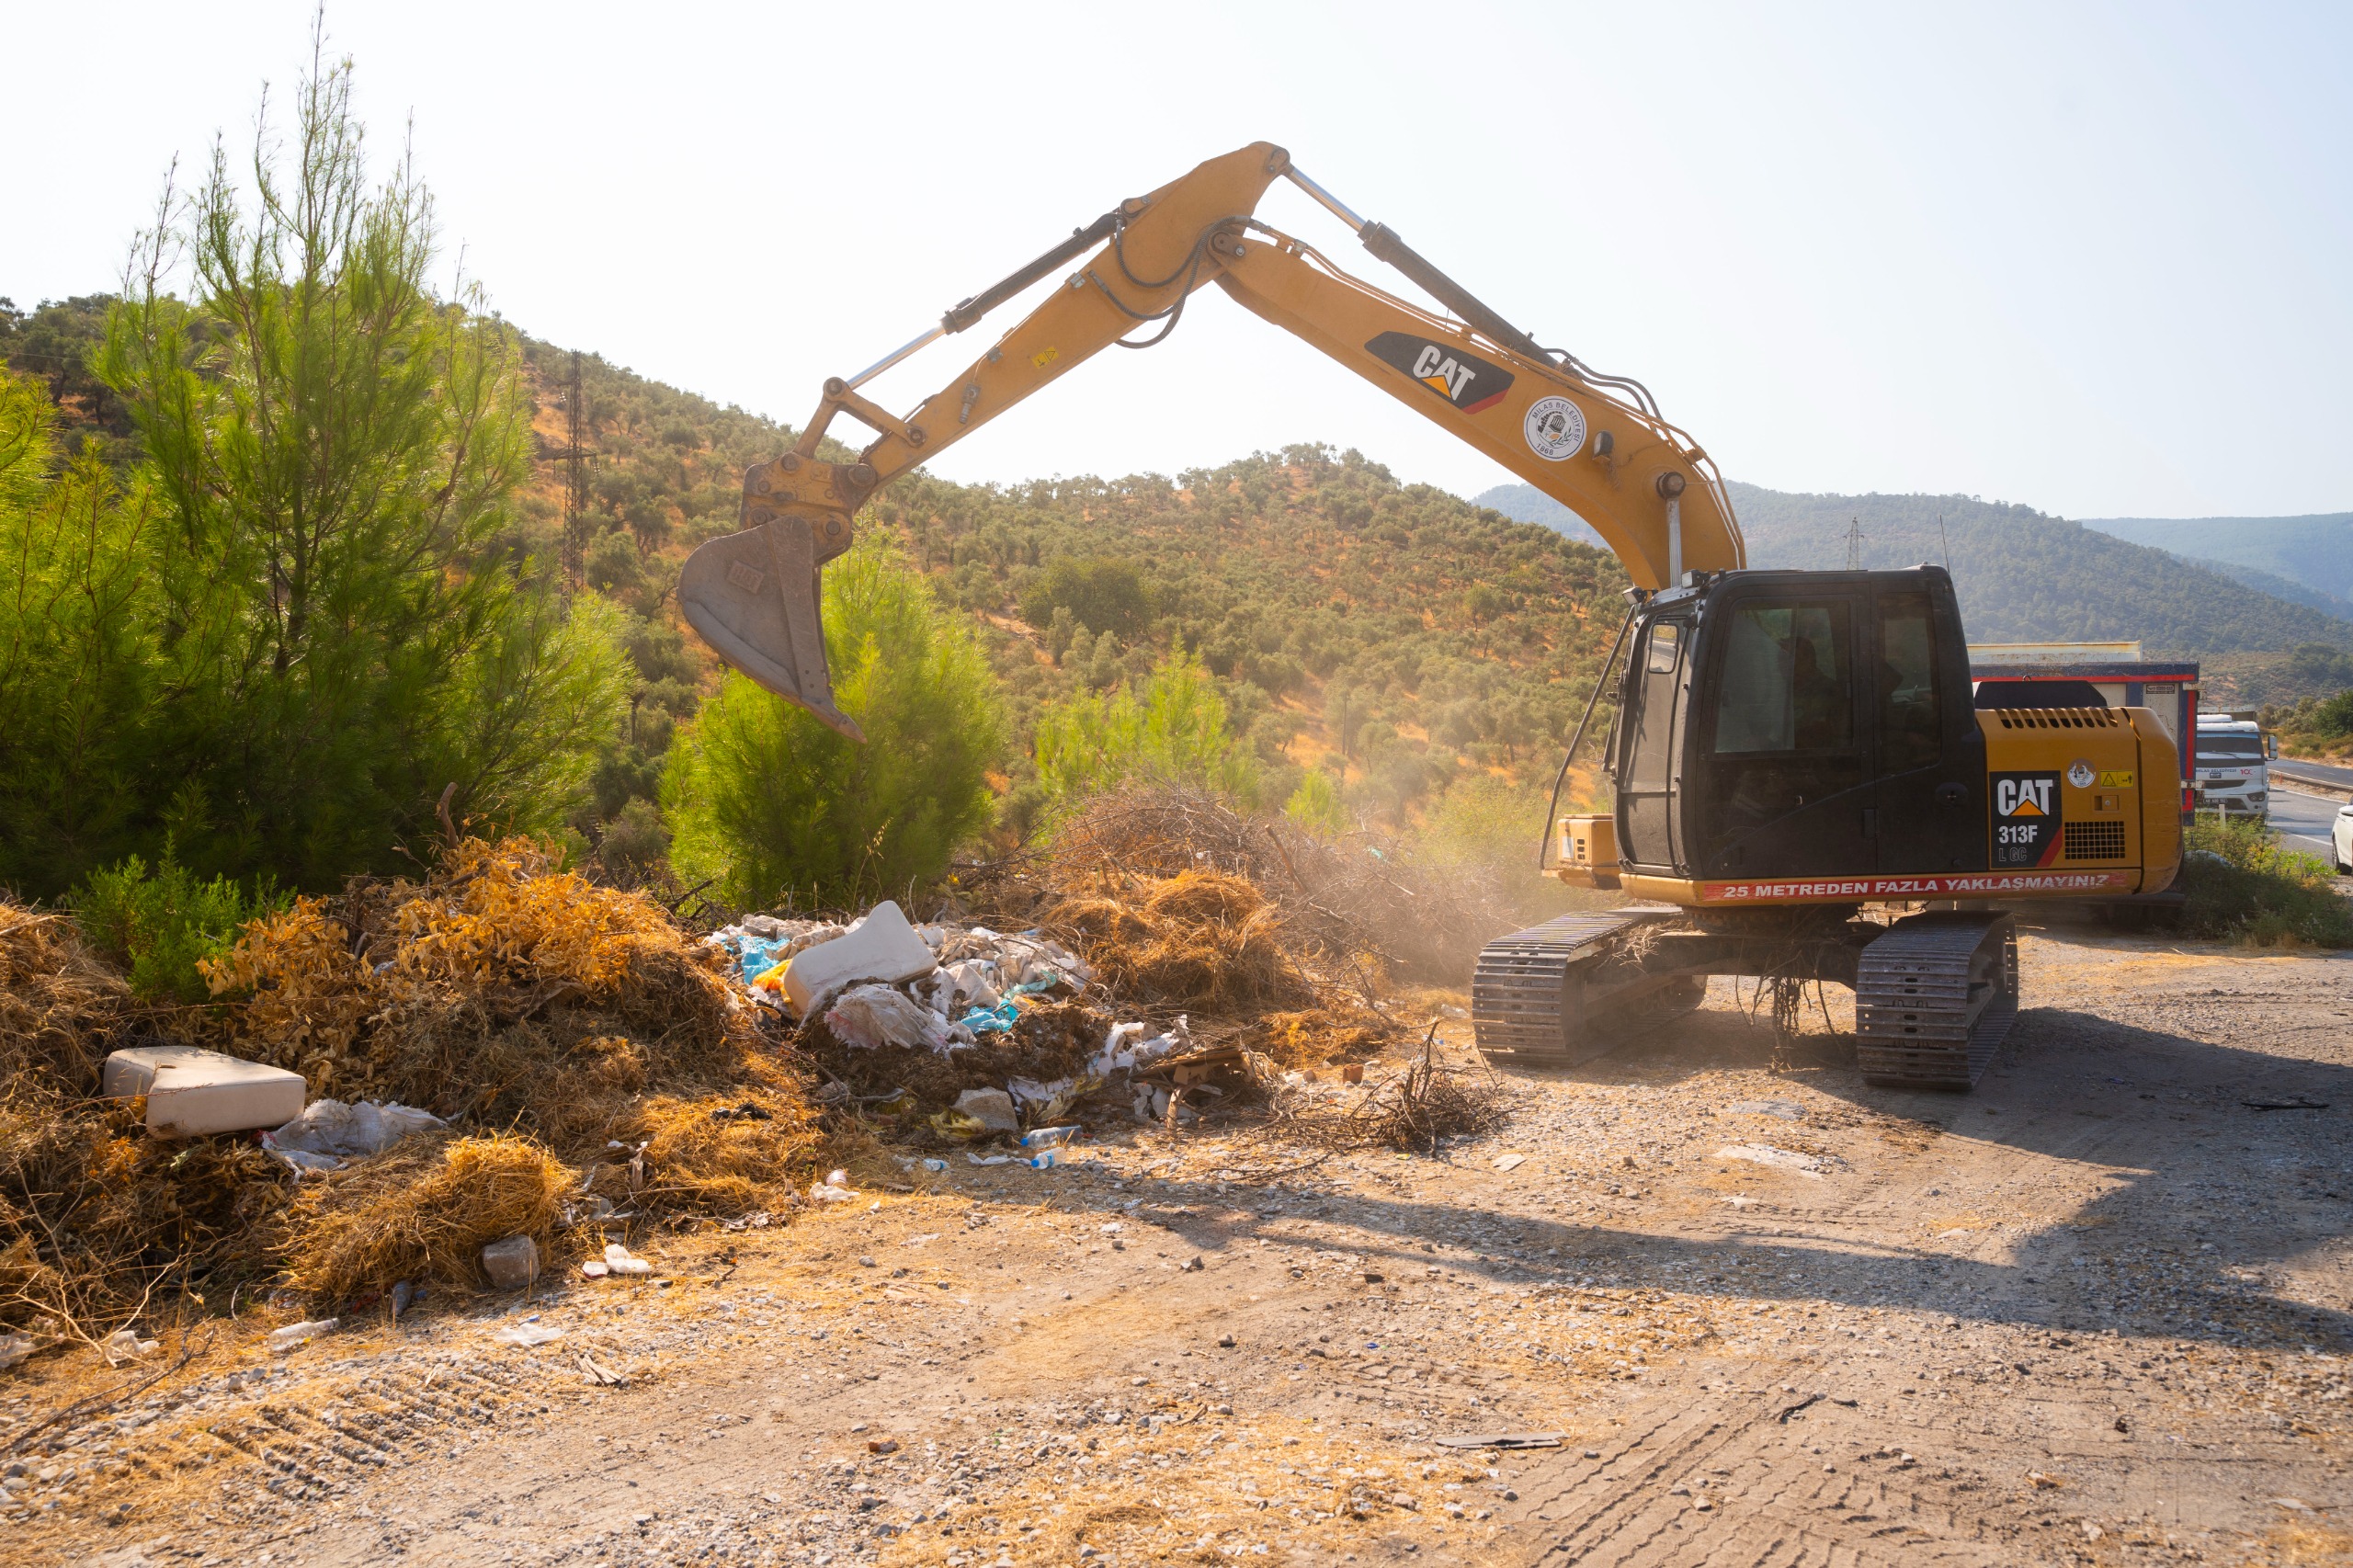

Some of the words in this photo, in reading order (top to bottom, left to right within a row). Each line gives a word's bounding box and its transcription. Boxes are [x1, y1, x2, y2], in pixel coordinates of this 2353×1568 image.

[1413, 345, 1476, 401] CAT
[1536, 443, 1554, 456] 1868
[1997, 778, 2053, 816] CAT
[1998, 824, 2038, 844] 313F
[1998, 847, 2006, 862] L
[2009, 846, 2027, 862] GC
[1722, 886, 1748, 898] 25
[1755, 881, 1869, 897] METREDEN
[1874, 880, 1938, 893] FAZLA
[1945, 874, 2109, 892] YAKLAŞMAYINIZ
